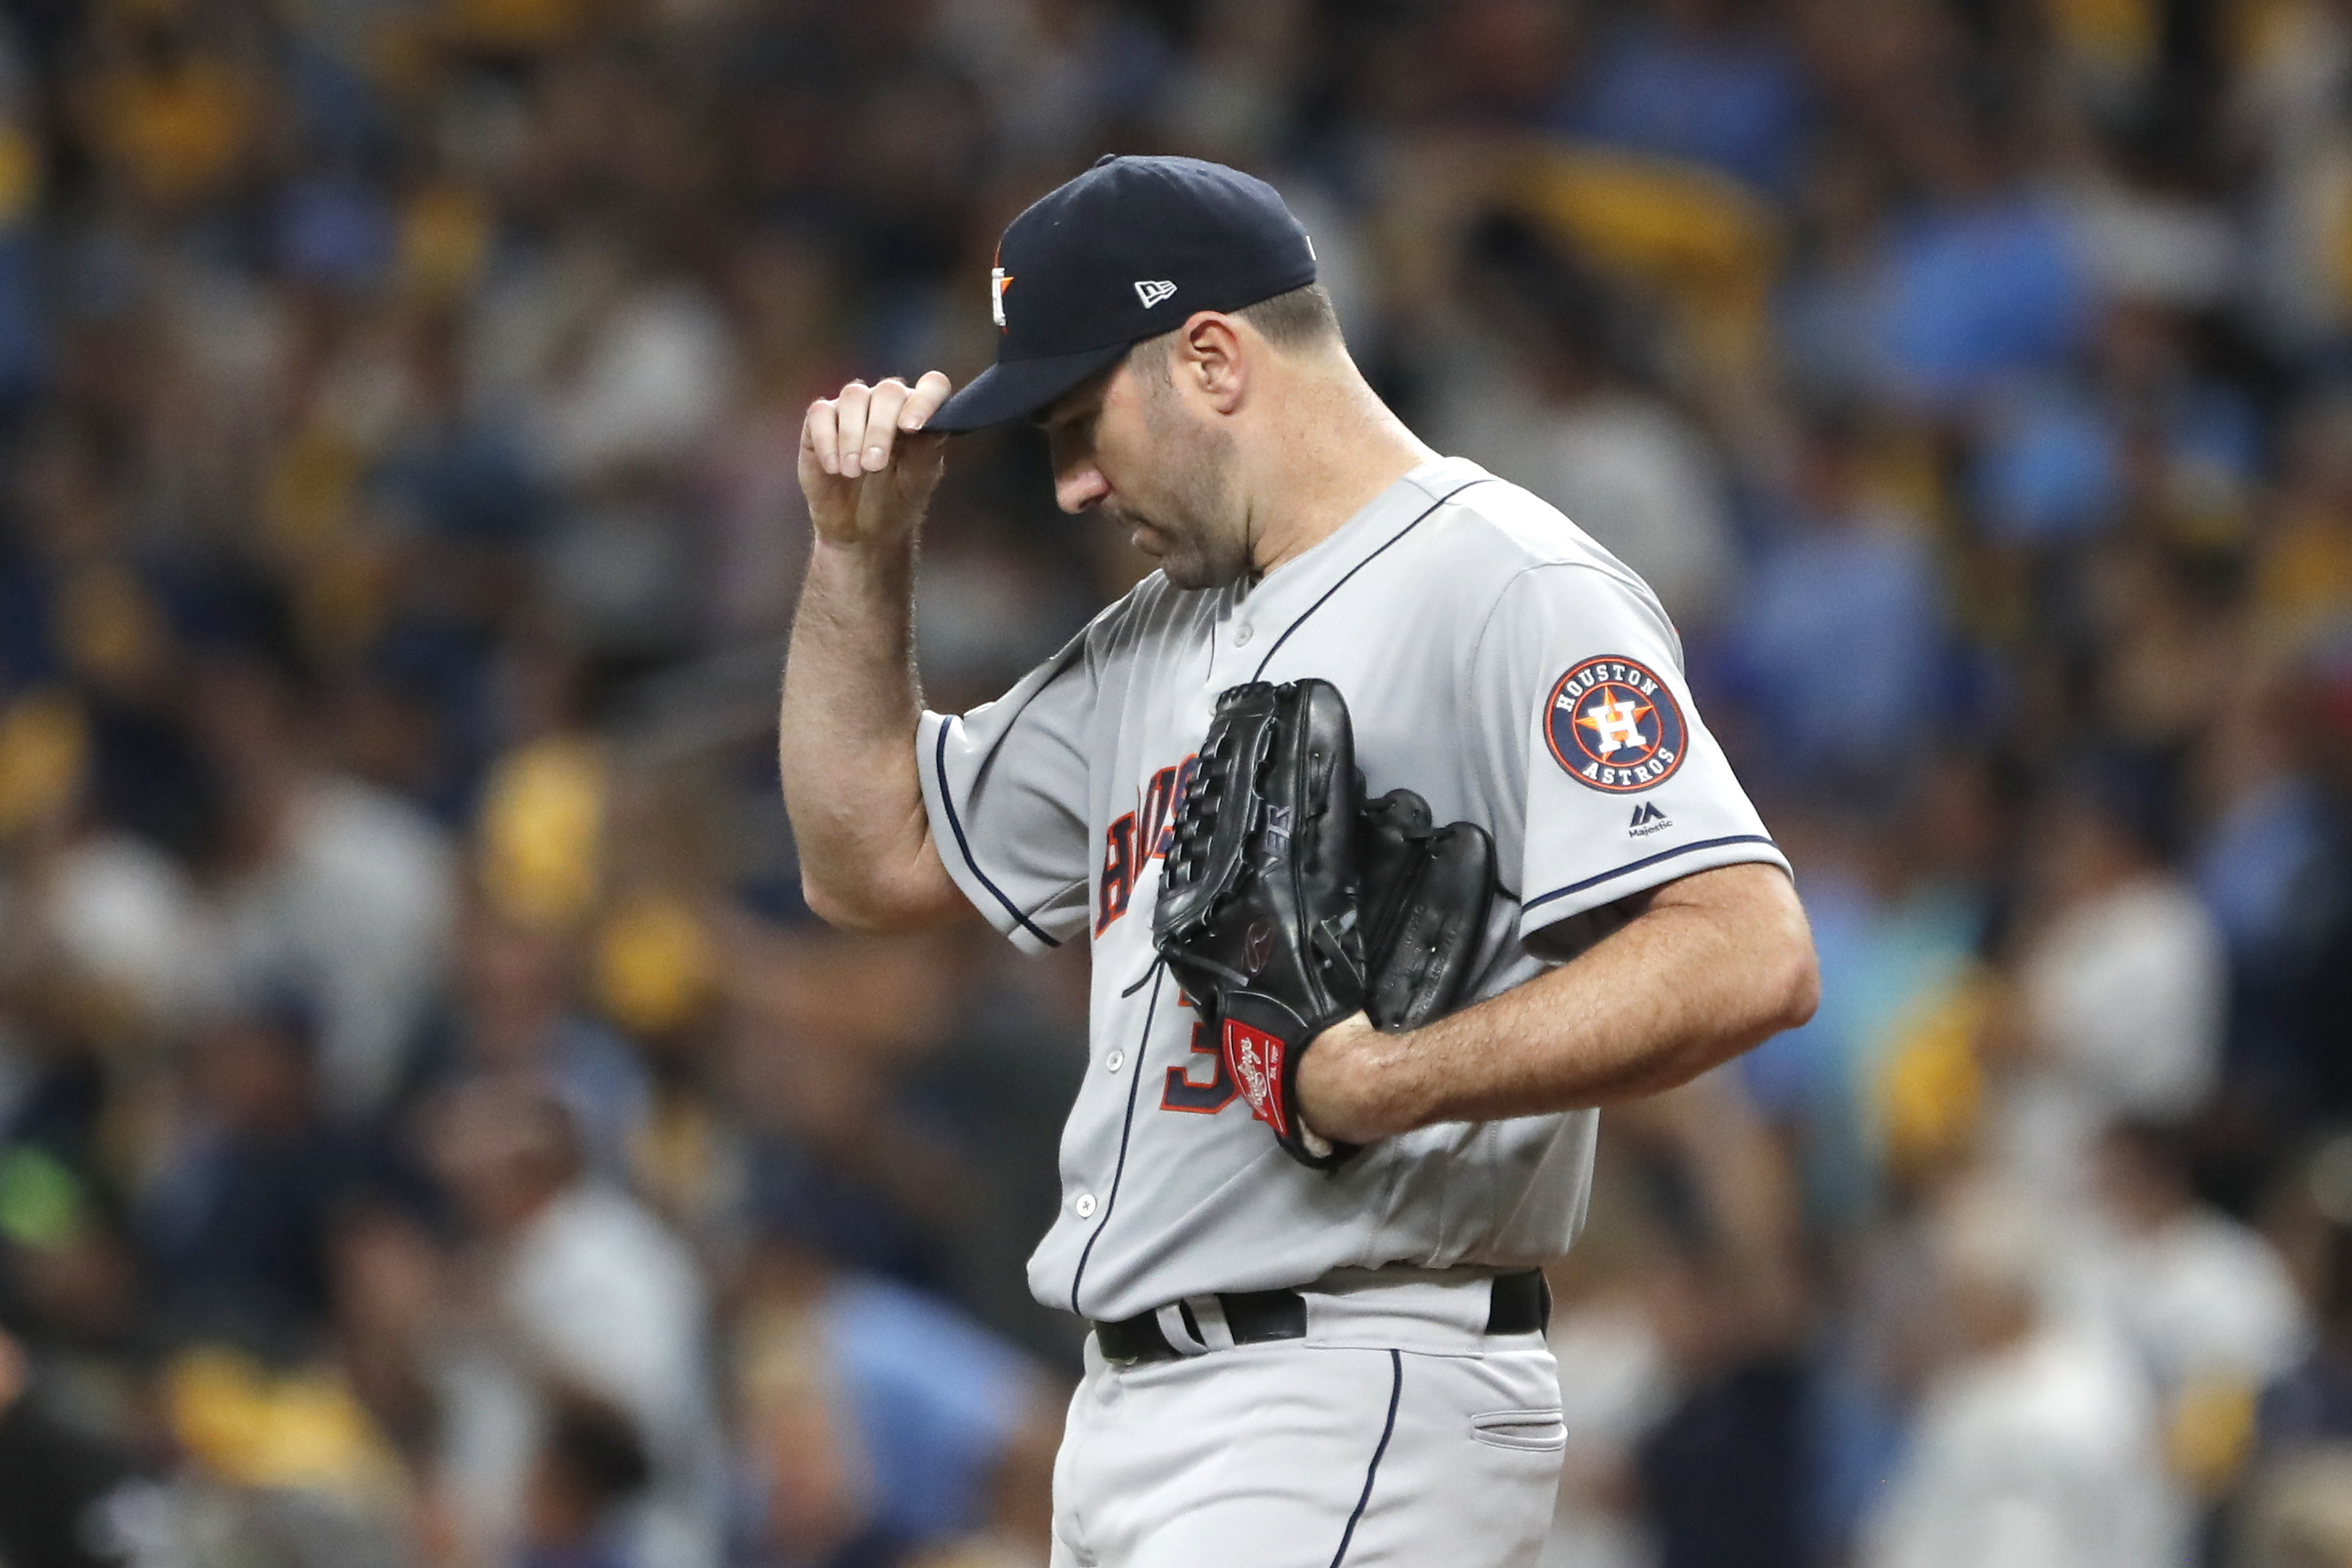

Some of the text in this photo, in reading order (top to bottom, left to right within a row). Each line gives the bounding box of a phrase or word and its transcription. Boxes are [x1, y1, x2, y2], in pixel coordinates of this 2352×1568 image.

[1556, 665, 1659, 712] HOUSTON
[1587, 701, 1647, 753] H
[1583, 747, 1675, 786] ASTROS
[1629, 821, 1673, 838] Majestic
